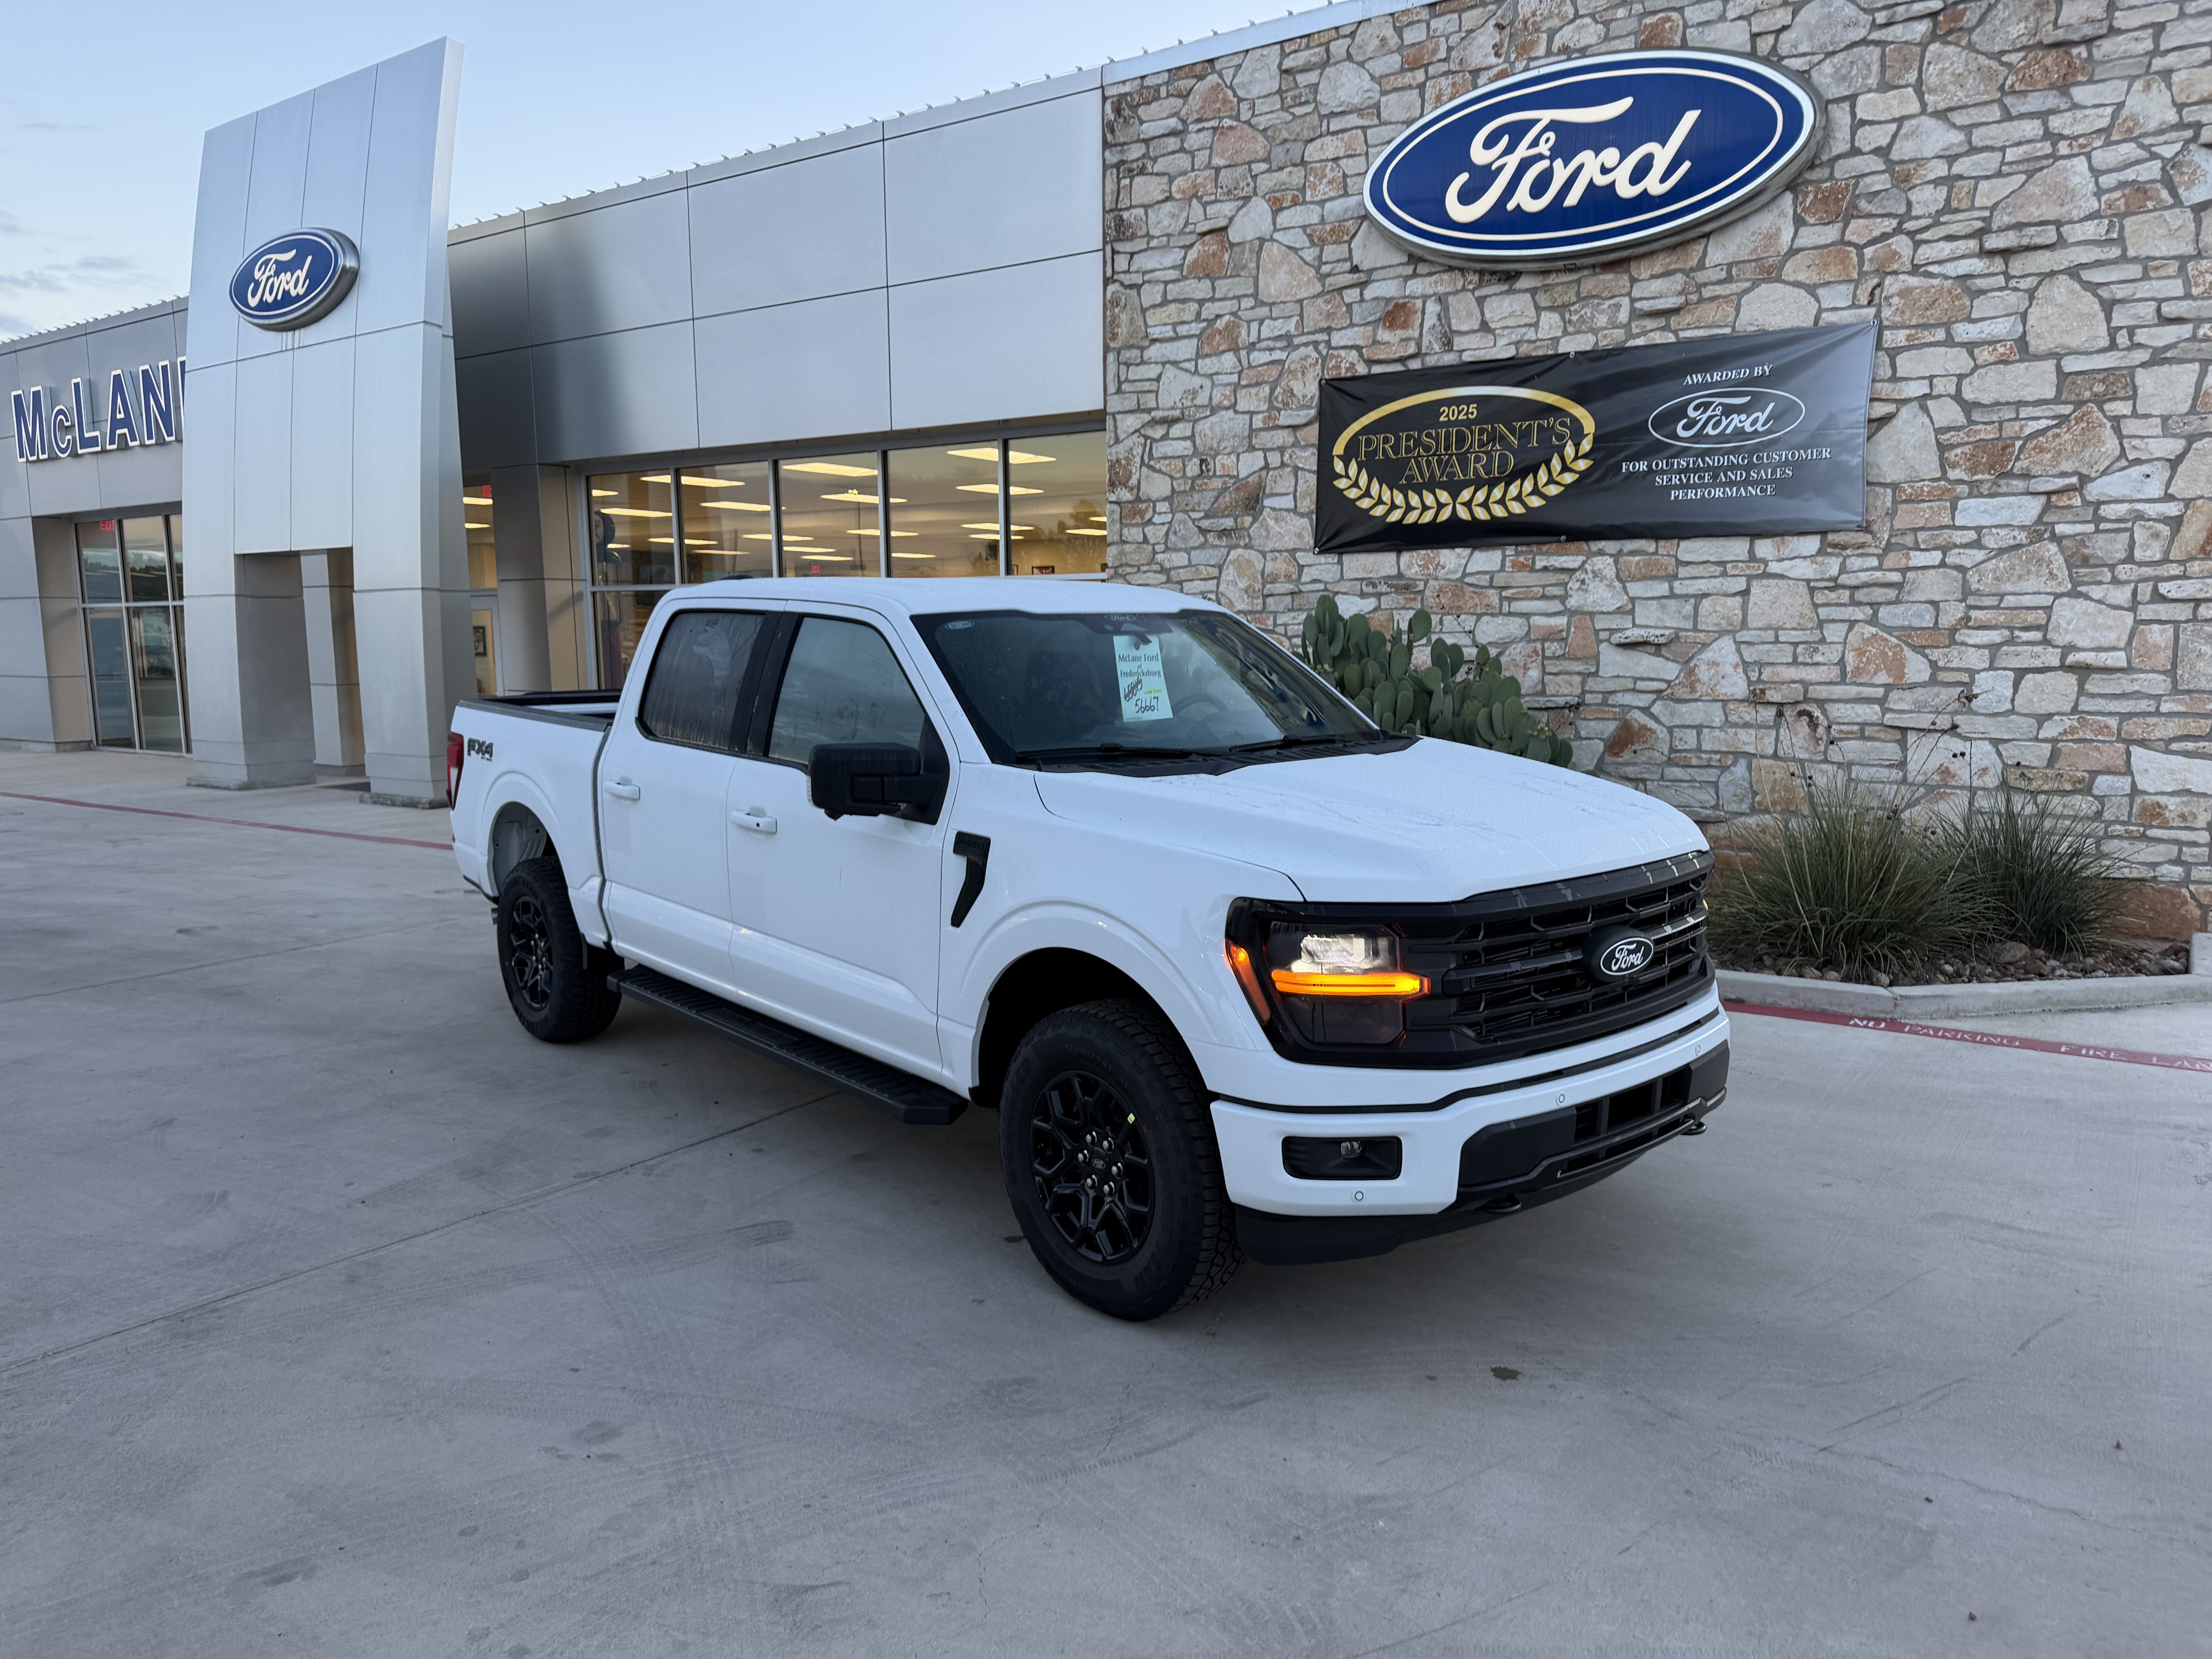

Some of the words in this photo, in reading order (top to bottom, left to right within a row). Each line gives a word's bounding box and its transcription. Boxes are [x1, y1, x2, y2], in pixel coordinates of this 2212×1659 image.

[1445, 96, 1702, 223] Ford
[247, 249, 313, 308] Ford
[1683, 368, 1750, 385] AWARDED
[1753, 364, 1773, 377] BY
[1439, 404, 1478, 422] 2025
[1676, 395, 1775, 438] Ford
[1357, 417, 1570, 461] PRESIDENT'S
[1398, 451, 1515, 484] AWARD
[1621, 461, 1648, 473] FOR
[1652, 453, 1748, 471] OUTSTANDING
[1753, 447, 1832, 464] CUSTOMER
[1655, 471, 1713, 486] SERVICE
[1717, 470, 1747, 482] AND
[1750, 467, 1794, 481] SALES
[1670, 484, 1776, 501] PERFORMANCE
[1118, 653, 1142, 662] McLane
[1144, 652, 1159, 662] Ford
[1120, 668, 1161, 678] Fredericksburg
[1135, 696, 1159, 714] 56667
[467, 737, 493, 757] FX4
[1611, 943, 1644, 971] Ford
[2060, 1045, 2128, 1060] FIRE
